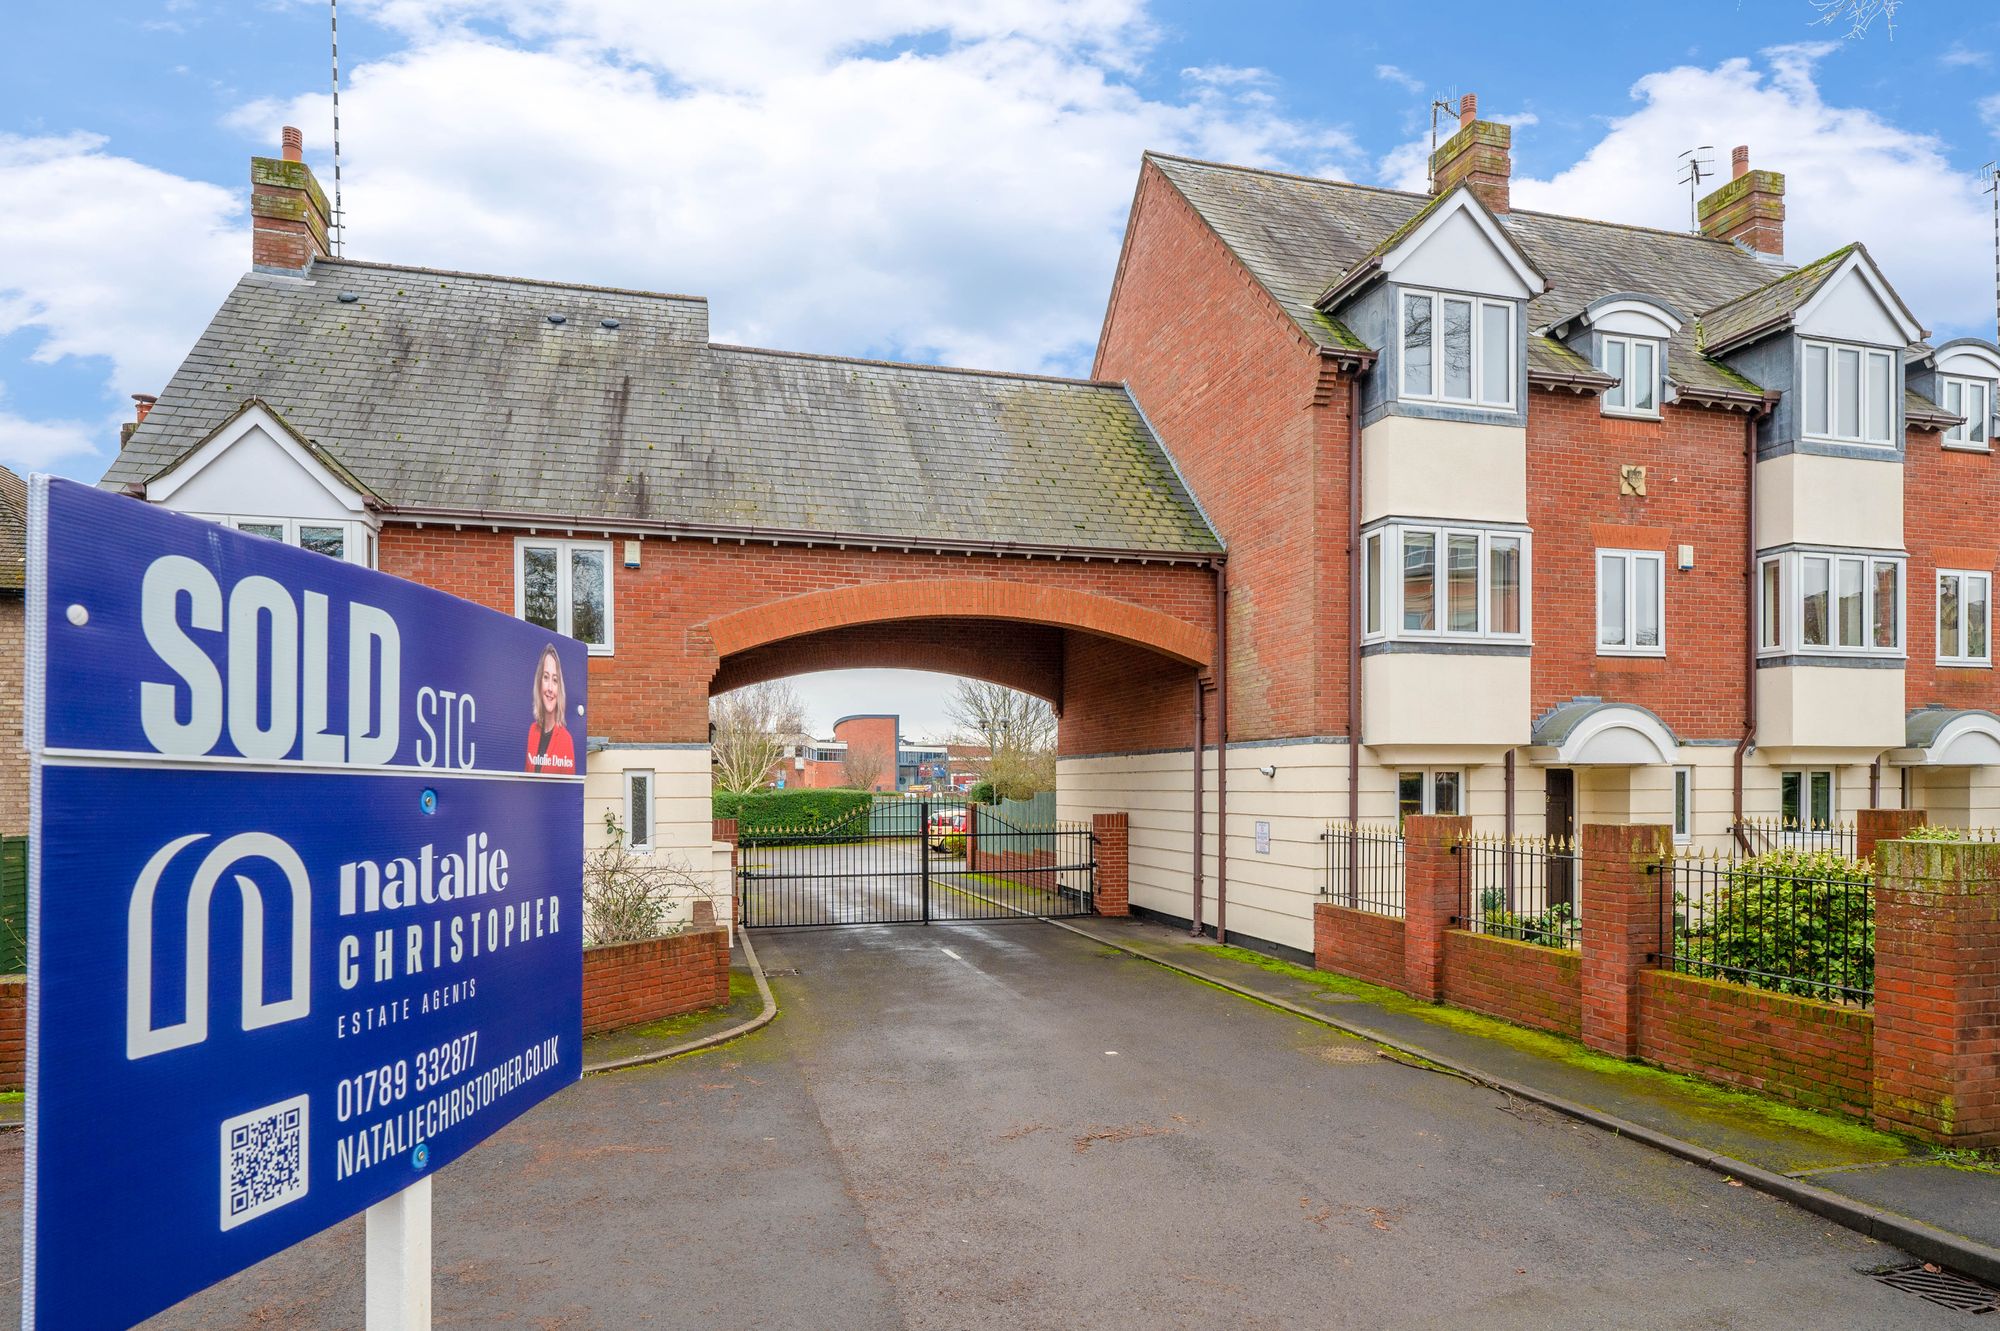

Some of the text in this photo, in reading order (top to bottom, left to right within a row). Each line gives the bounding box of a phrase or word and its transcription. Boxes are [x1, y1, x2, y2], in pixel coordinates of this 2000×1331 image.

[140, 554, 476, 770] SOLD STC
[528, 752, 573, 768] Natalie Davies
[339, 831, 509, 916] natalie
[338, 895, 560, 991] CHRISTOPHER
[337, 977, 477, 1039] ESTATE AGENTS
[336, 1034, 560, 1182] NATALIECHRISTOPHER.CO.UK
[337, 1030, 479, 1123] 01789 332877
